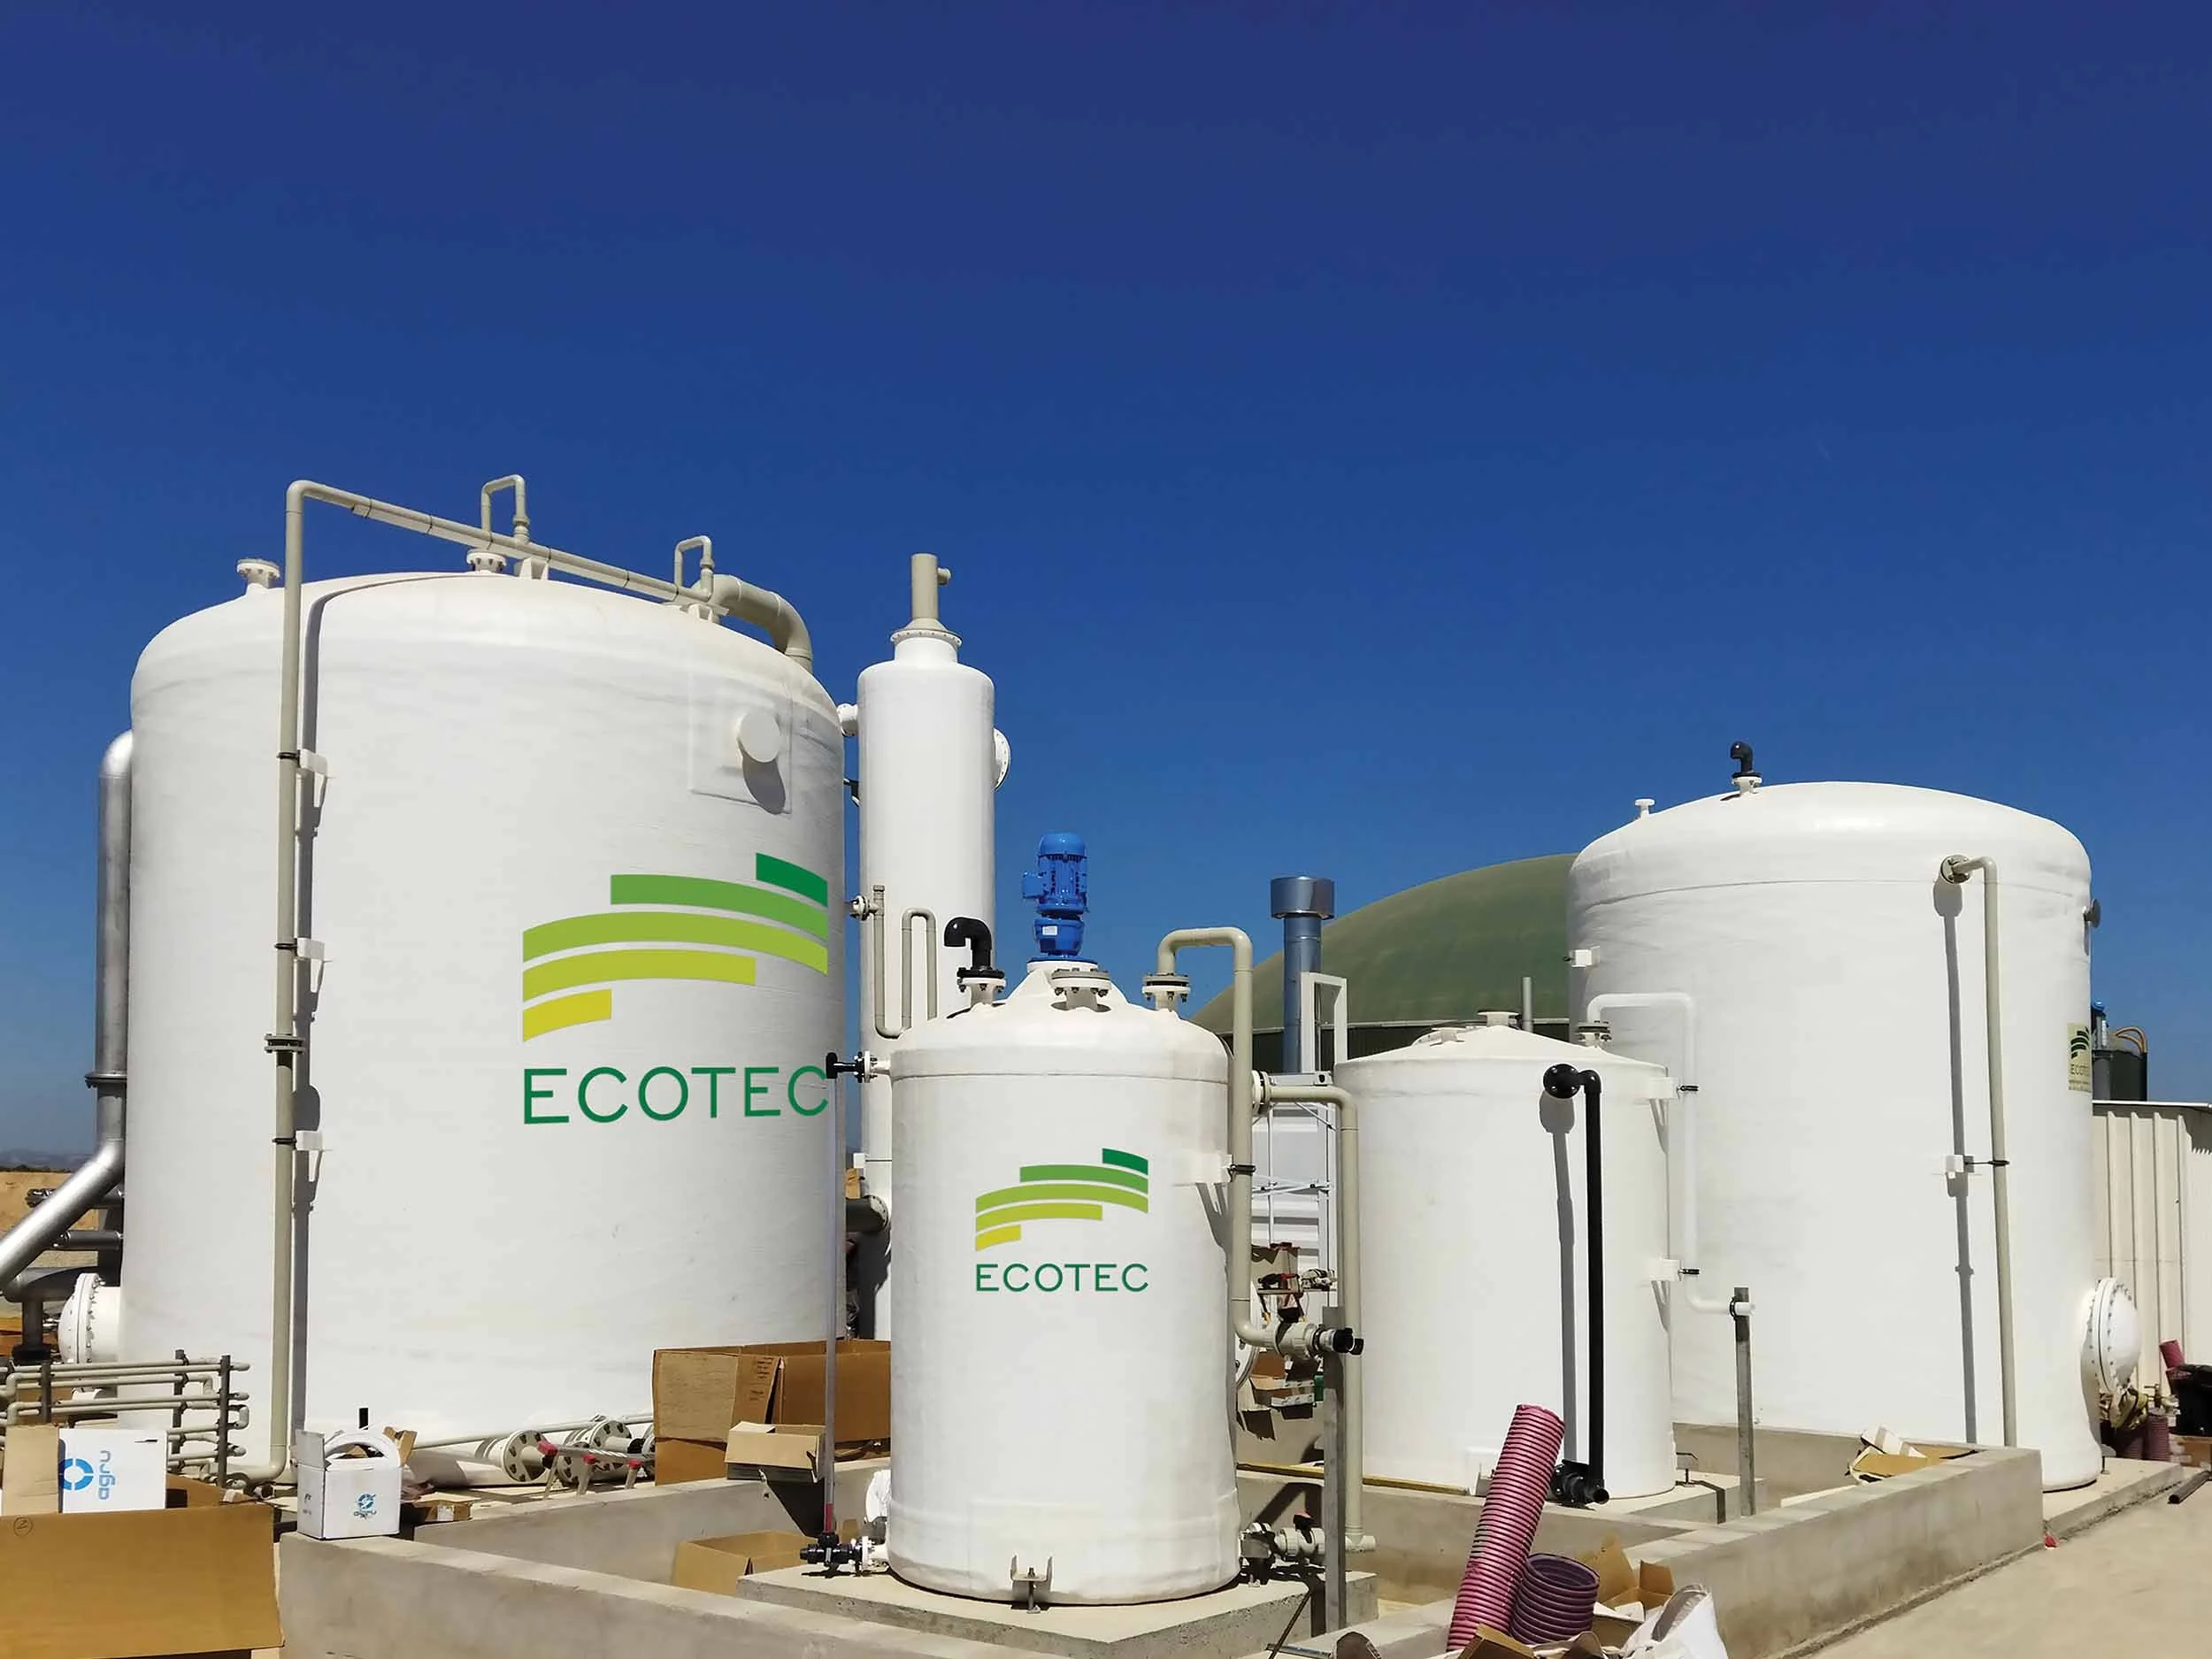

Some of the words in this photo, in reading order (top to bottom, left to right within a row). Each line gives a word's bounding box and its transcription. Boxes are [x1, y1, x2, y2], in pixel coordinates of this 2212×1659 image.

[524, 1065, 828, 1124] ECOTEC
[976, 1263, 1148, 1292] ECOTEC
[98, 1450, 116, 1500] agru
